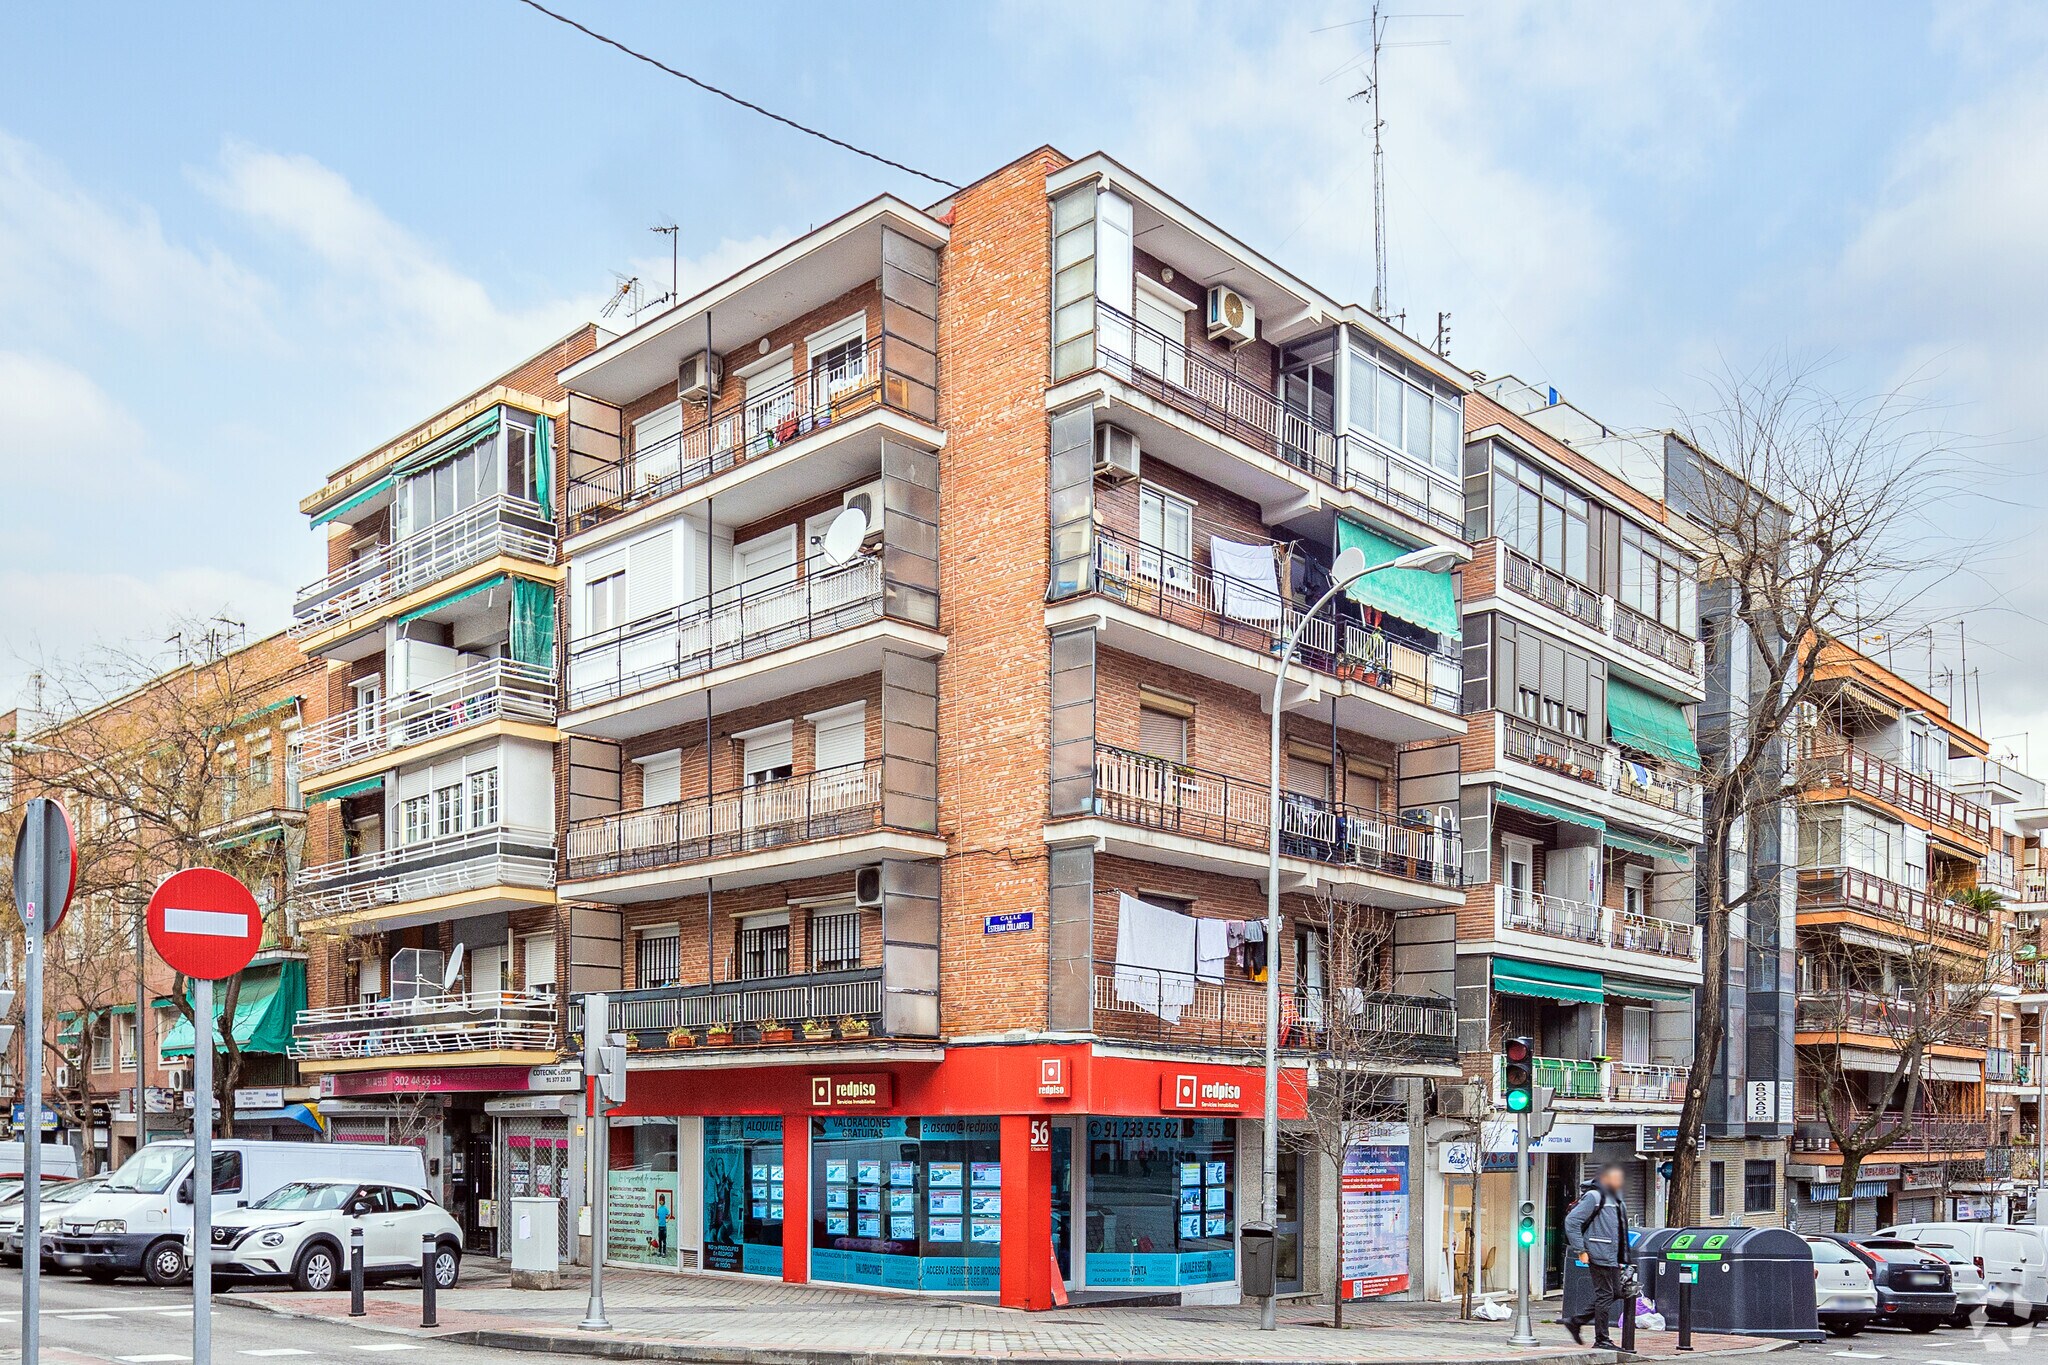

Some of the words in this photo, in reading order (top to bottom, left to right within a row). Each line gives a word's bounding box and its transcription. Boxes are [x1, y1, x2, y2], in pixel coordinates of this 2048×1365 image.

[395, 1075, 409, 1085] 902
[411, 1075, 421, 1085] 44
[422, 1075, 431, 1085] 55
[432, 1075, 441, 1085] 33
[836, 1081, 876, 1098] redpiso
[1038, 1085, 1065, 1095] redpiso
[1201, 1081, 1241, 1100] redpiso
[1755, 1082, 1767, 1116] ABOGADO
[834, 1117, 891, 1128] VALORACIONES
[842, 1128, 884, 1138] GRATUITAS
[1030, 1120, 1049, 1145] 56
[1104, 1121, 1118, 1138] 91
[1121, 1121, 1143, 1138] 233
[1146, 1121, 1161, 1139] 55
[1163, 1121, 1179, 1139] 82
[926, 1266, 944, 1275] ACCESO
[945, 1266, 950, 1275] A
[950, 1265, 973, 1275] REGISTRO
[973, 1266, 980, 1275] DE
[1131, 1265, 1148, 1276] VENTA
[947, 1277, 969, 1287] ALQUILER
[970, 1277, 990, 1287] SEGURO
